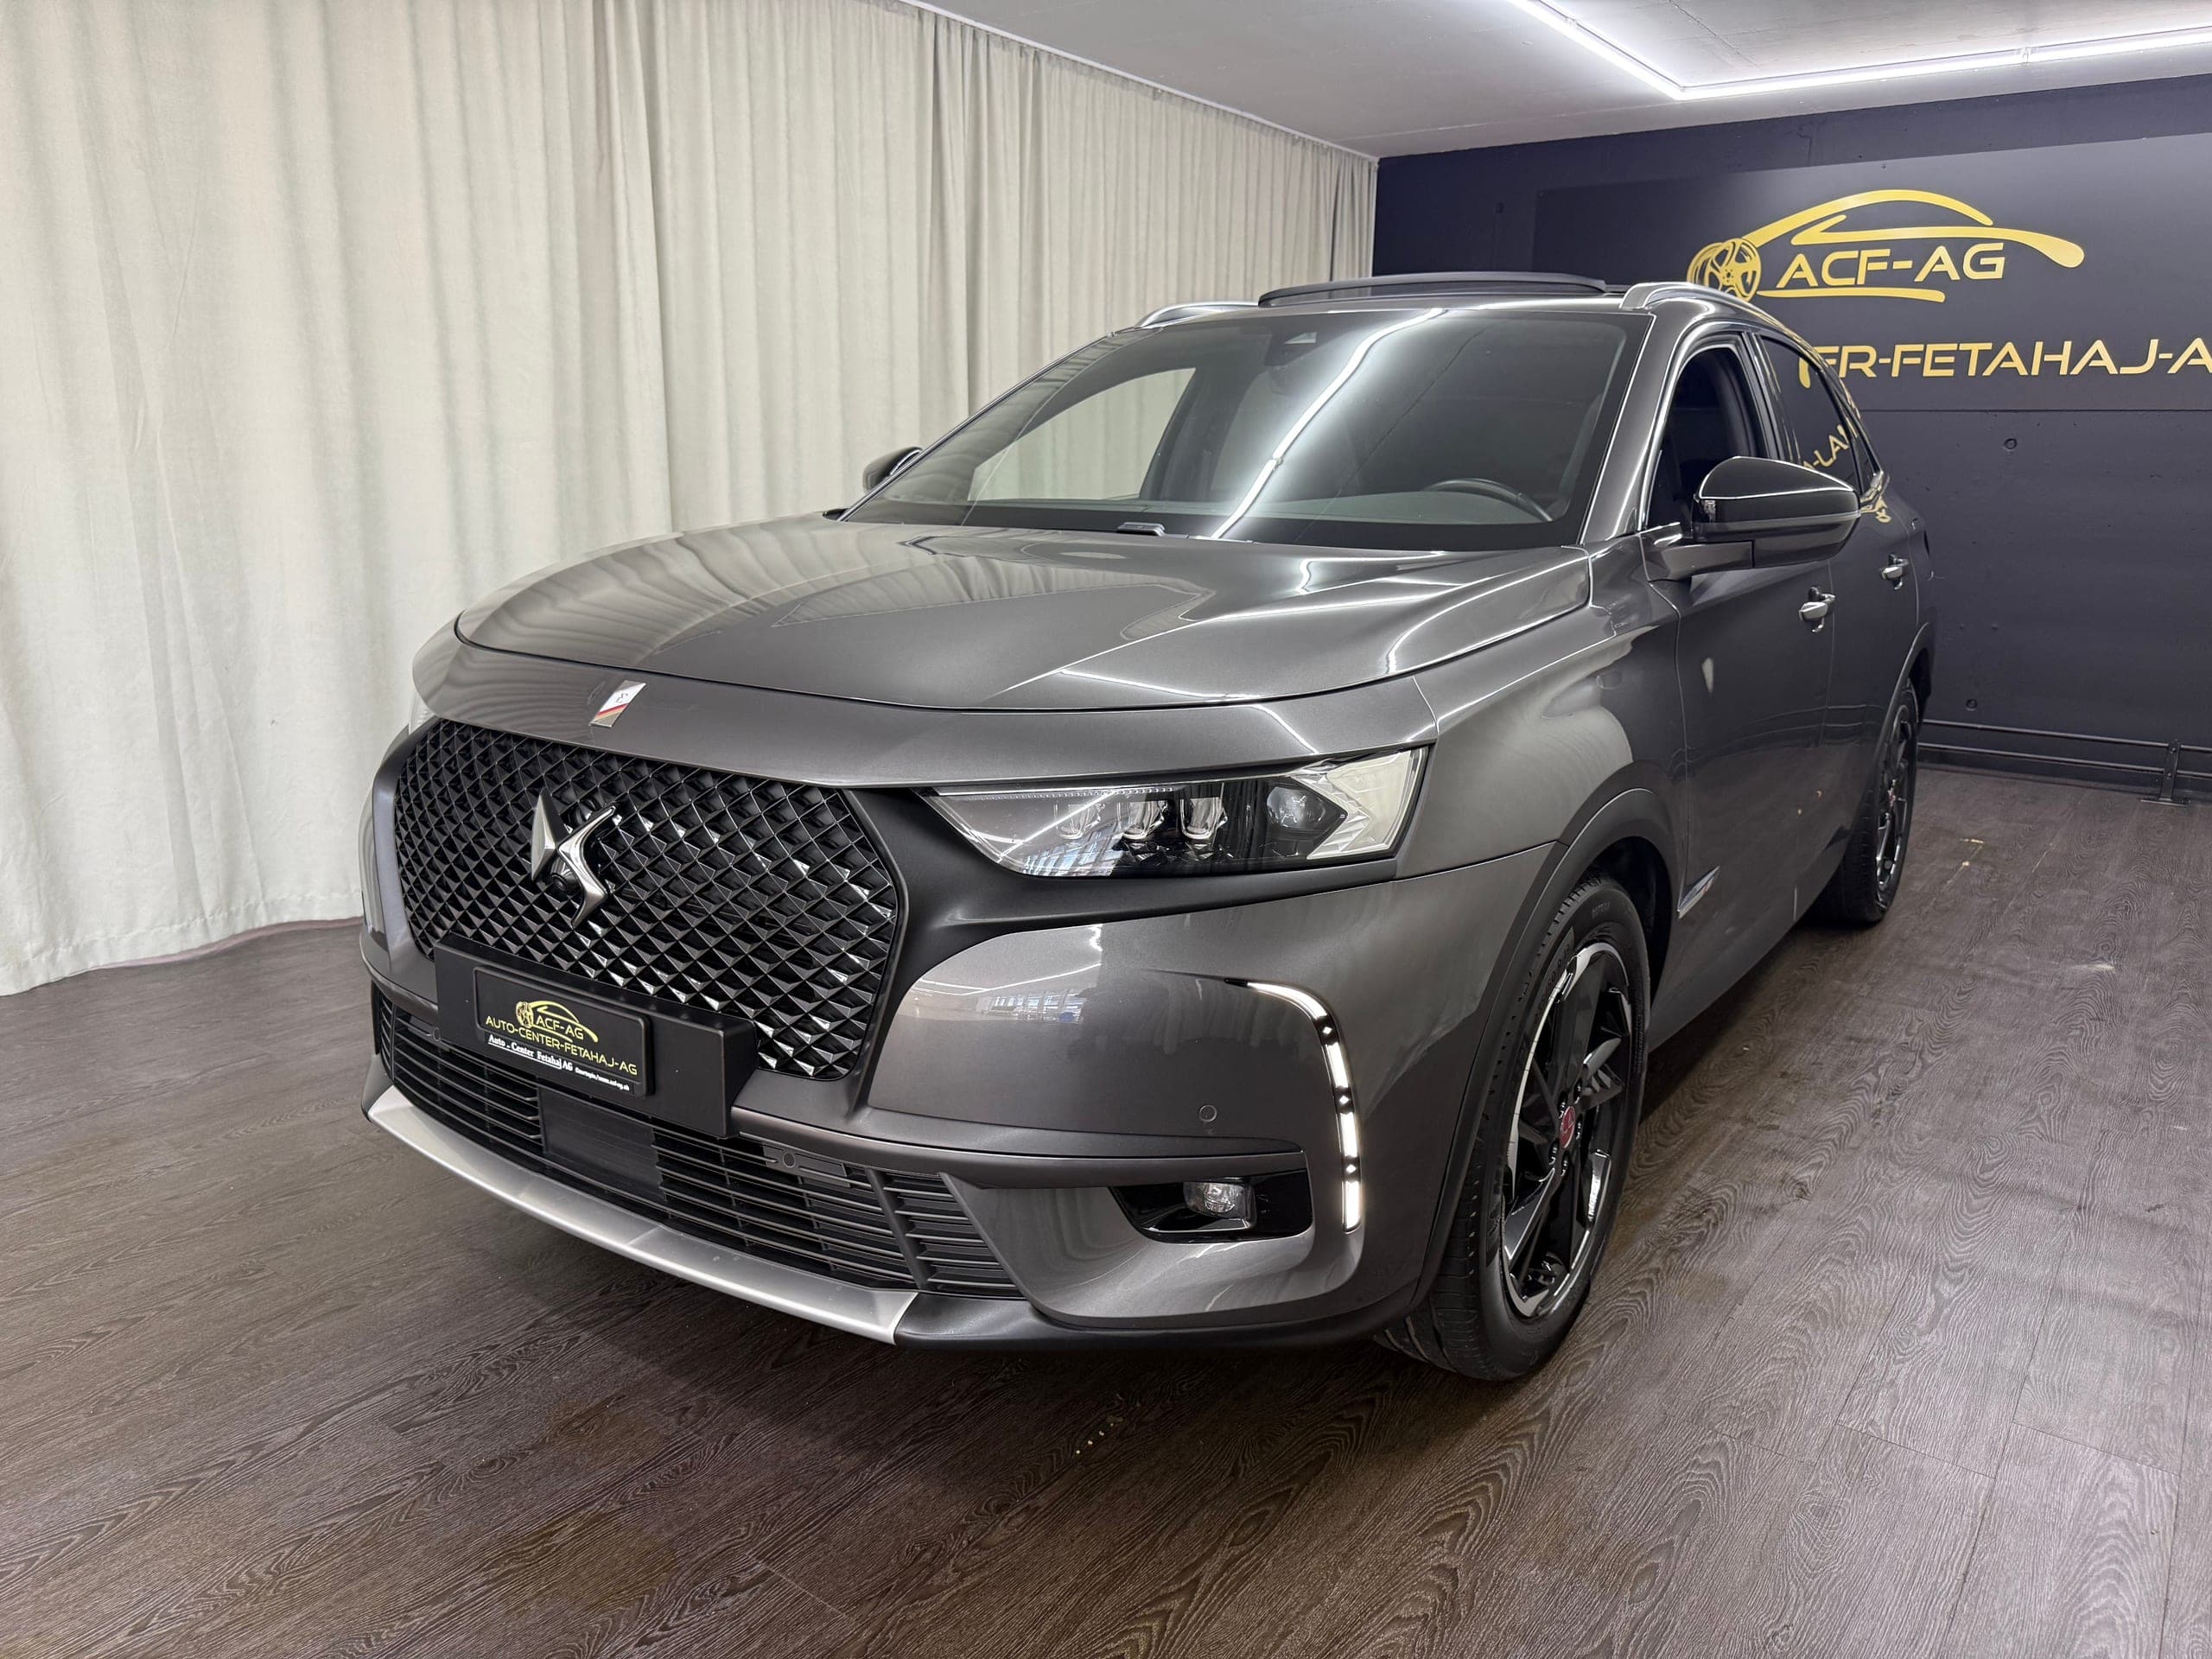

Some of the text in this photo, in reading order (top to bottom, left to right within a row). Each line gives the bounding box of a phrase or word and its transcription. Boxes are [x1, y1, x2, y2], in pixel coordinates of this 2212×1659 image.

[1776, 241, 2005, 289] ACF-AG
[486, 1015, 638, 1076] AUTO-CENTER-FETAHAJ-AG
[536, 1014, 584, 1040] ACF-AG
[488, 1033, 505, 1047] Auto
[511, 1041, 534, 1058] Center
[563, 1060, 574, 1071] AG
